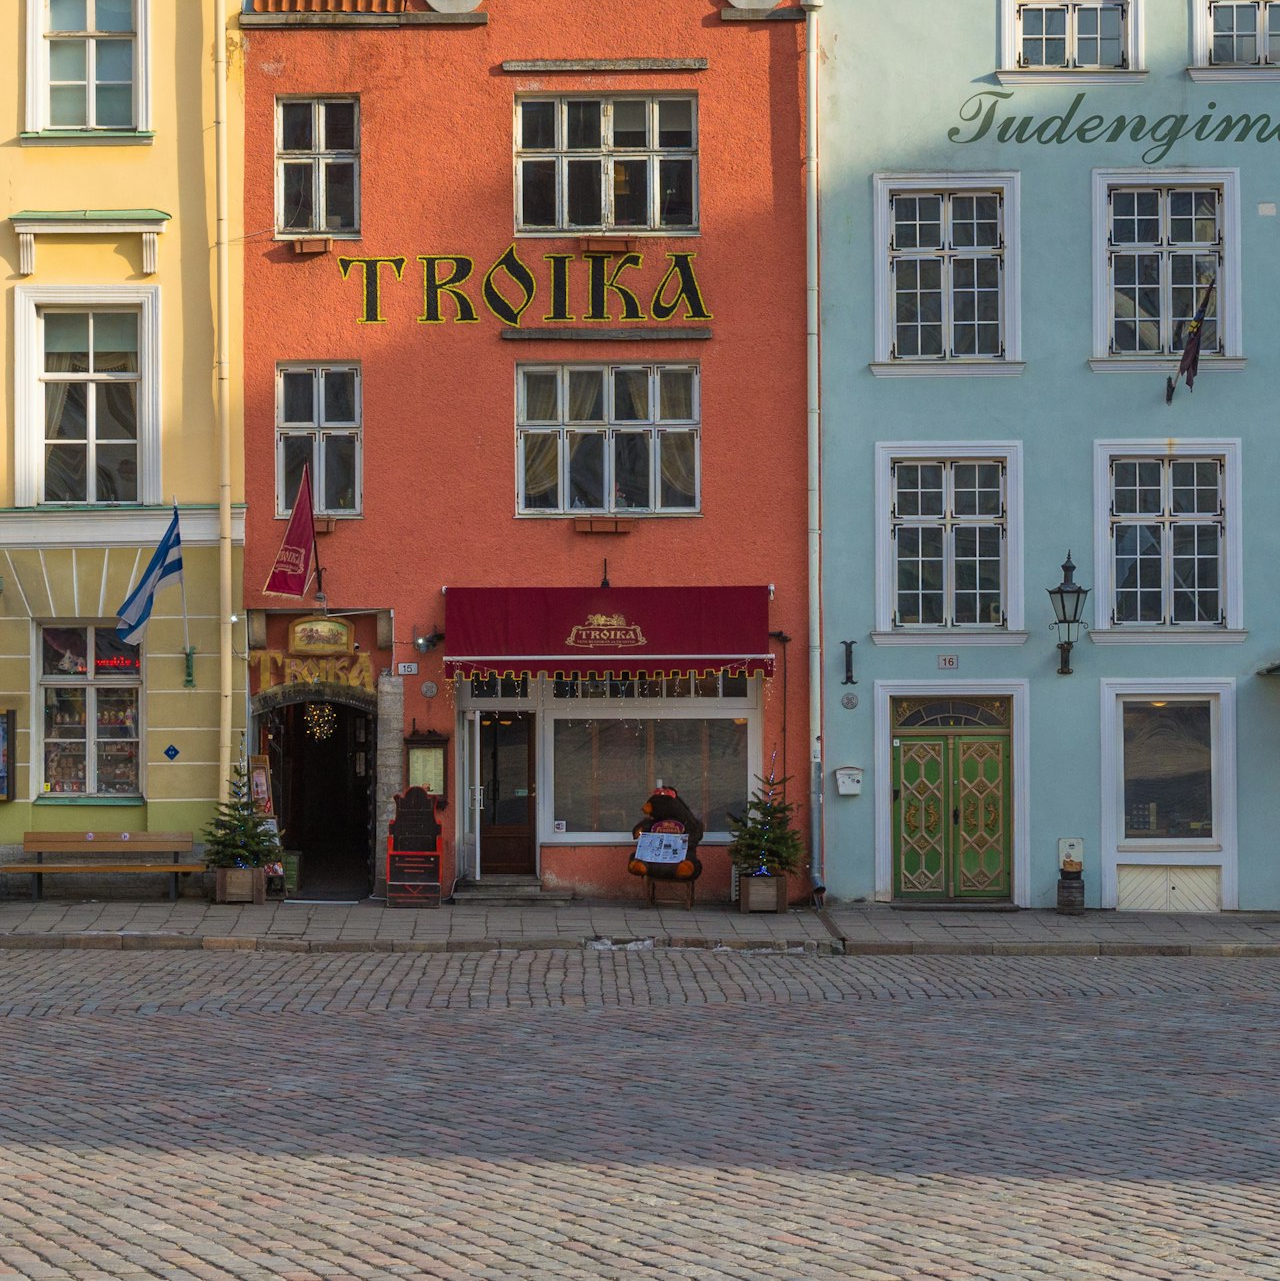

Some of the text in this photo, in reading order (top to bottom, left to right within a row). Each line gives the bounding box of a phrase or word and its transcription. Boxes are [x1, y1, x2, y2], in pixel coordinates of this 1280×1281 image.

[337, 242, 714, 328] TROIKA
[579, 629, 636, 641] TROIKA
[942, 657, 955, 667] 16
[249, 649, 378, 695] TROIKA
[402, 664, 413, 673] 15
